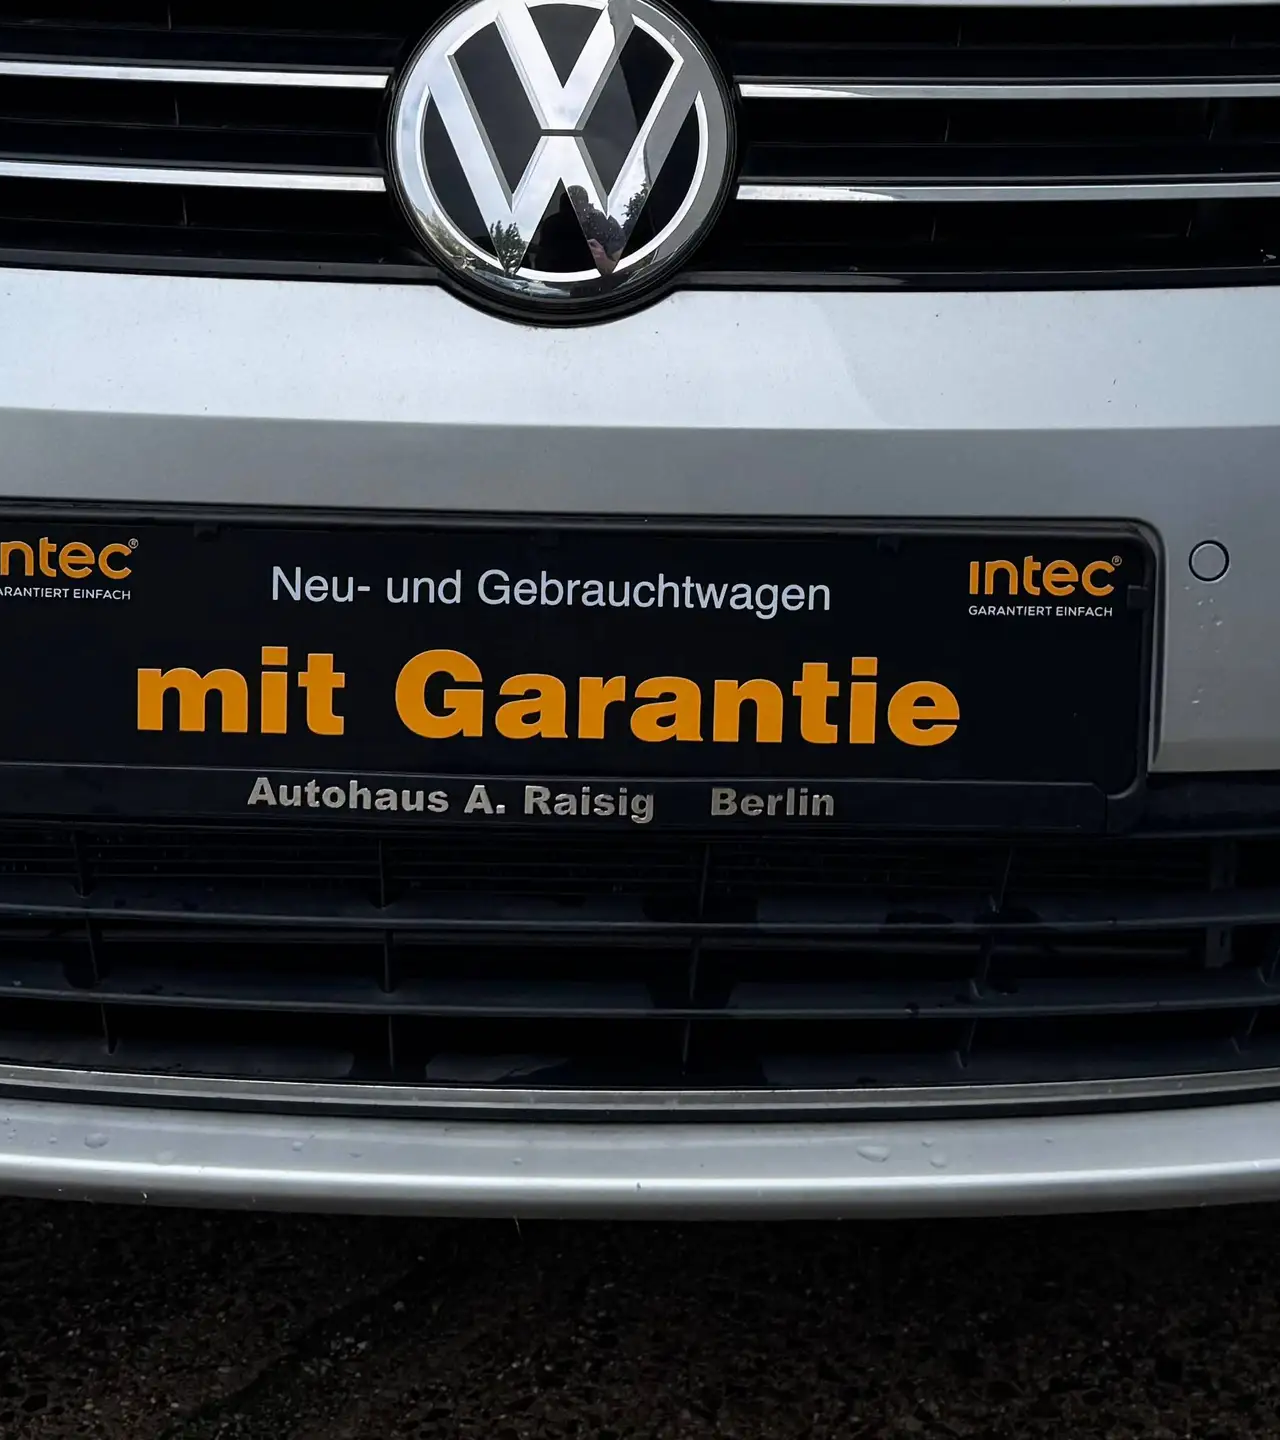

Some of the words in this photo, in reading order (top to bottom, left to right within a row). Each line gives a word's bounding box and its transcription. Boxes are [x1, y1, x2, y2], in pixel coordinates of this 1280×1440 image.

[73, 588, 131, 601] EINFACH
[271, 566, 371, 603] Neu-
[386, 570, 462, 604] und
[477, 568, 832, 620] Gebrauchtwagen
[968, 605, 1052, 617] GARANTIERT
[1055, 606, 1113, 618] EINFACH
[136, 645, 345, 736] mit
[395, 648, 961, 747] Garantie
[247, 776, 450, 814] Autohaus
[463, 784, 506, 816] A.
[524, 784, 655, 824] Raisig
[710, 786, 835, 818] Berlin
